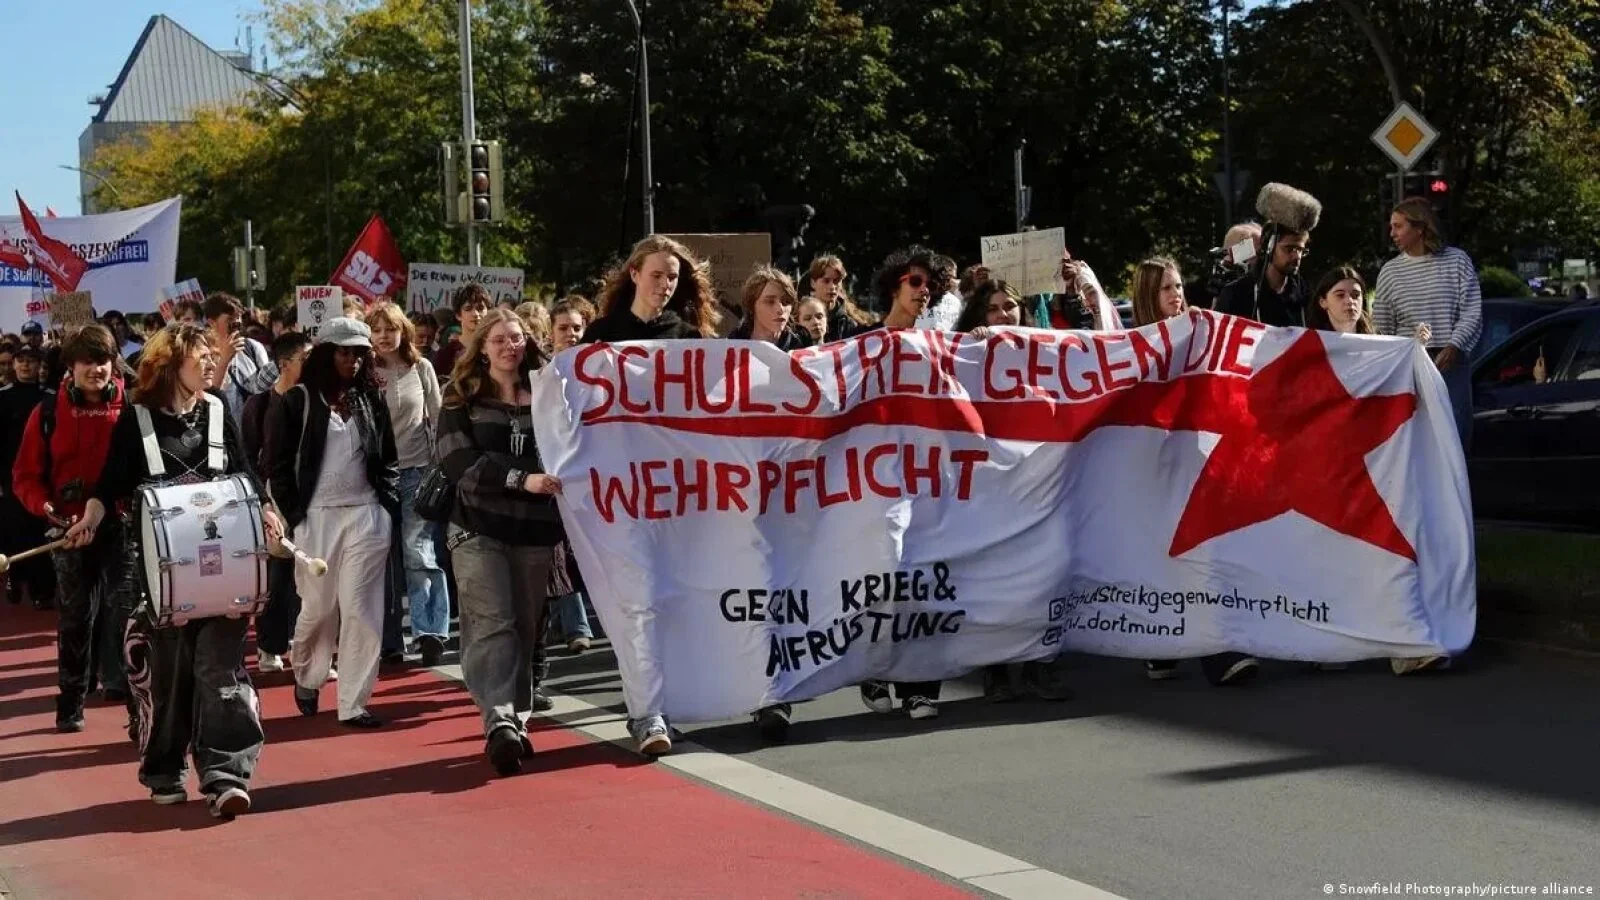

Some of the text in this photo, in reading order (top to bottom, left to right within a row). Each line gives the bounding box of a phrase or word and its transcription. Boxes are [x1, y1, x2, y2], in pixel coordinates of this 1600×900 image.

[984, 320, 1173, 400] GEGEN
[1184, 311, 1266, 376] DIE
[590, 443, 988, 524] WEHRPFLICHT
